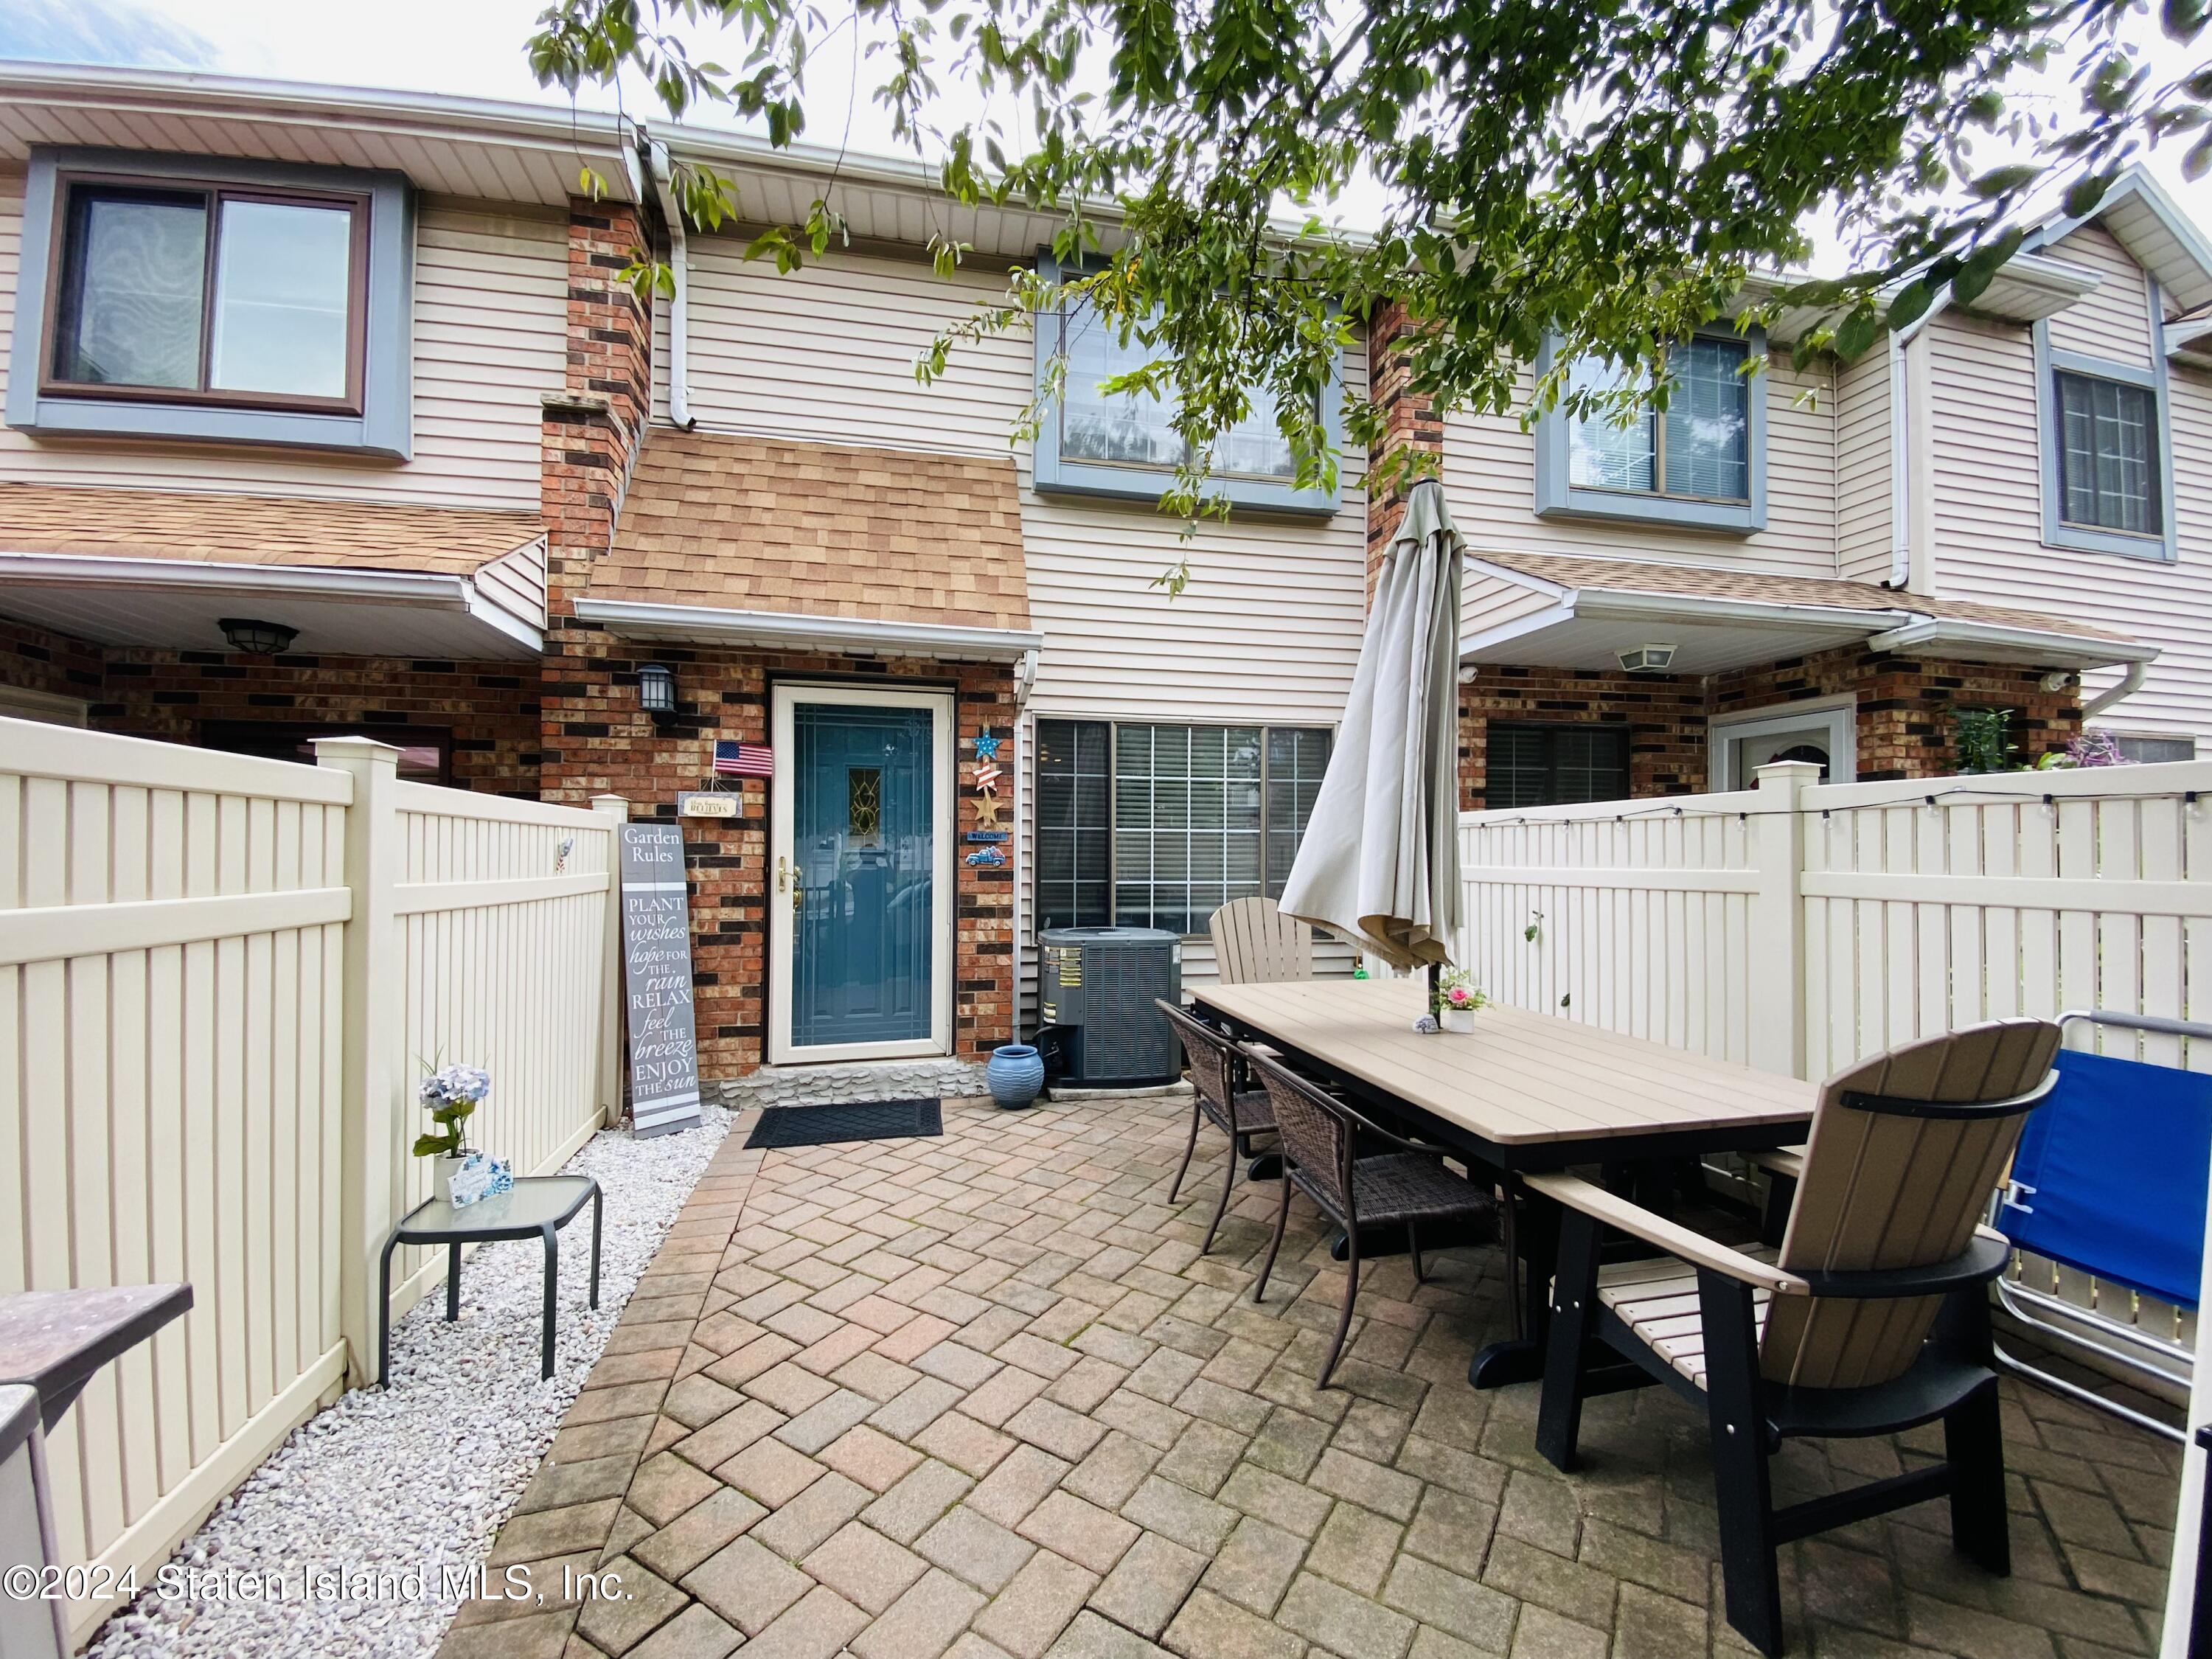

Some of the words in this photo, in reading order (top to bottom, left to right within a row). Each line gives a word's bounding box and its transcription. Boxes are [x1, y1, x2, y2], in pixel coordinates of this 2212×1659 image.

[625, 828, 680, 845] Garden
[633, 846, 674, 862] Rules
[629, 897, 684, 912] PLANT
[629, 914, 665, 926] YOUR
[630, 917, 686, 941] wishes
[629, 940, 666, 975] hope
[666, 950, 687, 960] FOR
[647, 964, 671, 975] THE
[645, 970, 687, 992] rain
[632, 989, 692, 1009] RELAX
[633, 1006, 675, 1039] feel
[660, 1027, 686, 1041] THE
[634, 1032, 693, 1060] breeze
[636, 1057, 693, 1082] ENJOY
[636, 1082, 663, 1096] THE
[664, 1074, 696, 1092] sun
